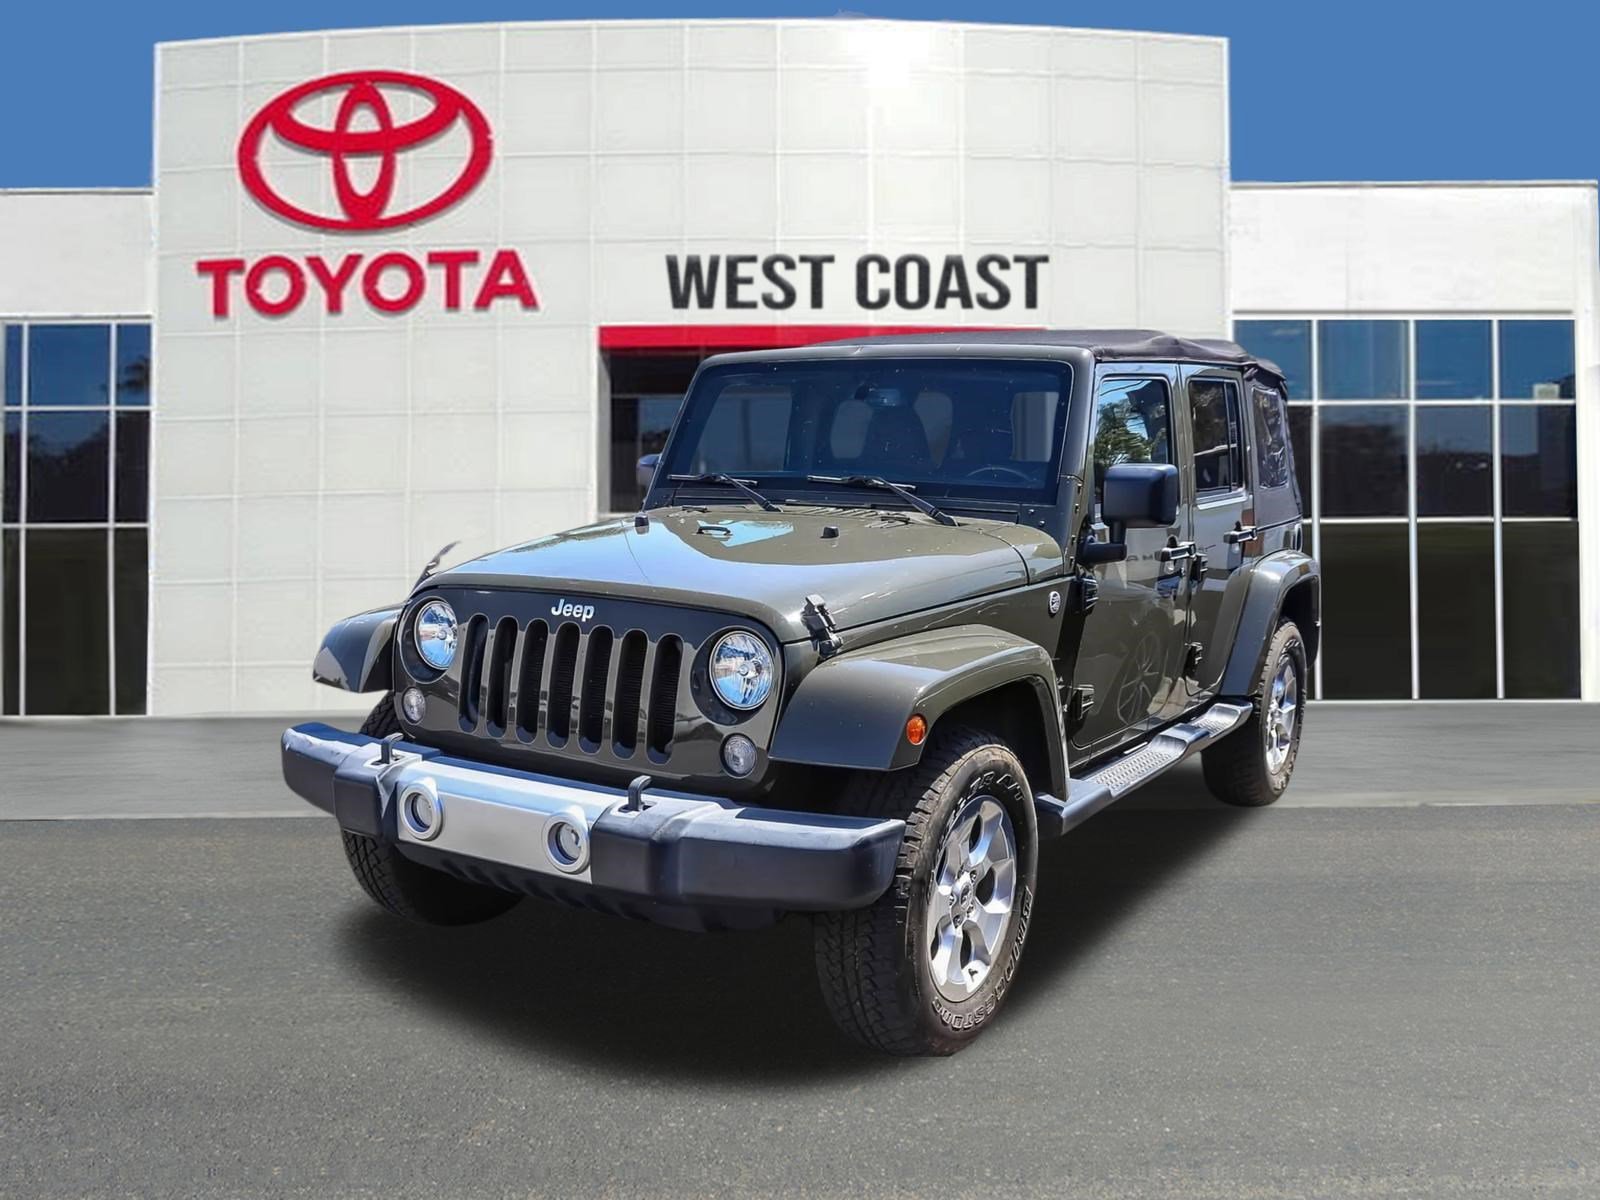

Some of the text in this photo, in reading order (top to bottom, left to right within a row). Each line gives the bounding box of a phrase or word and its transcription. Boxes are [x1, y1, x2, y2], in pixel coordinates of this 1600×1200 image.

[197, 250, 539, 317] TOYOTA
[665, 253, 1050, 311] WEST COAST
[551, 598, 595, 622] Jeep
